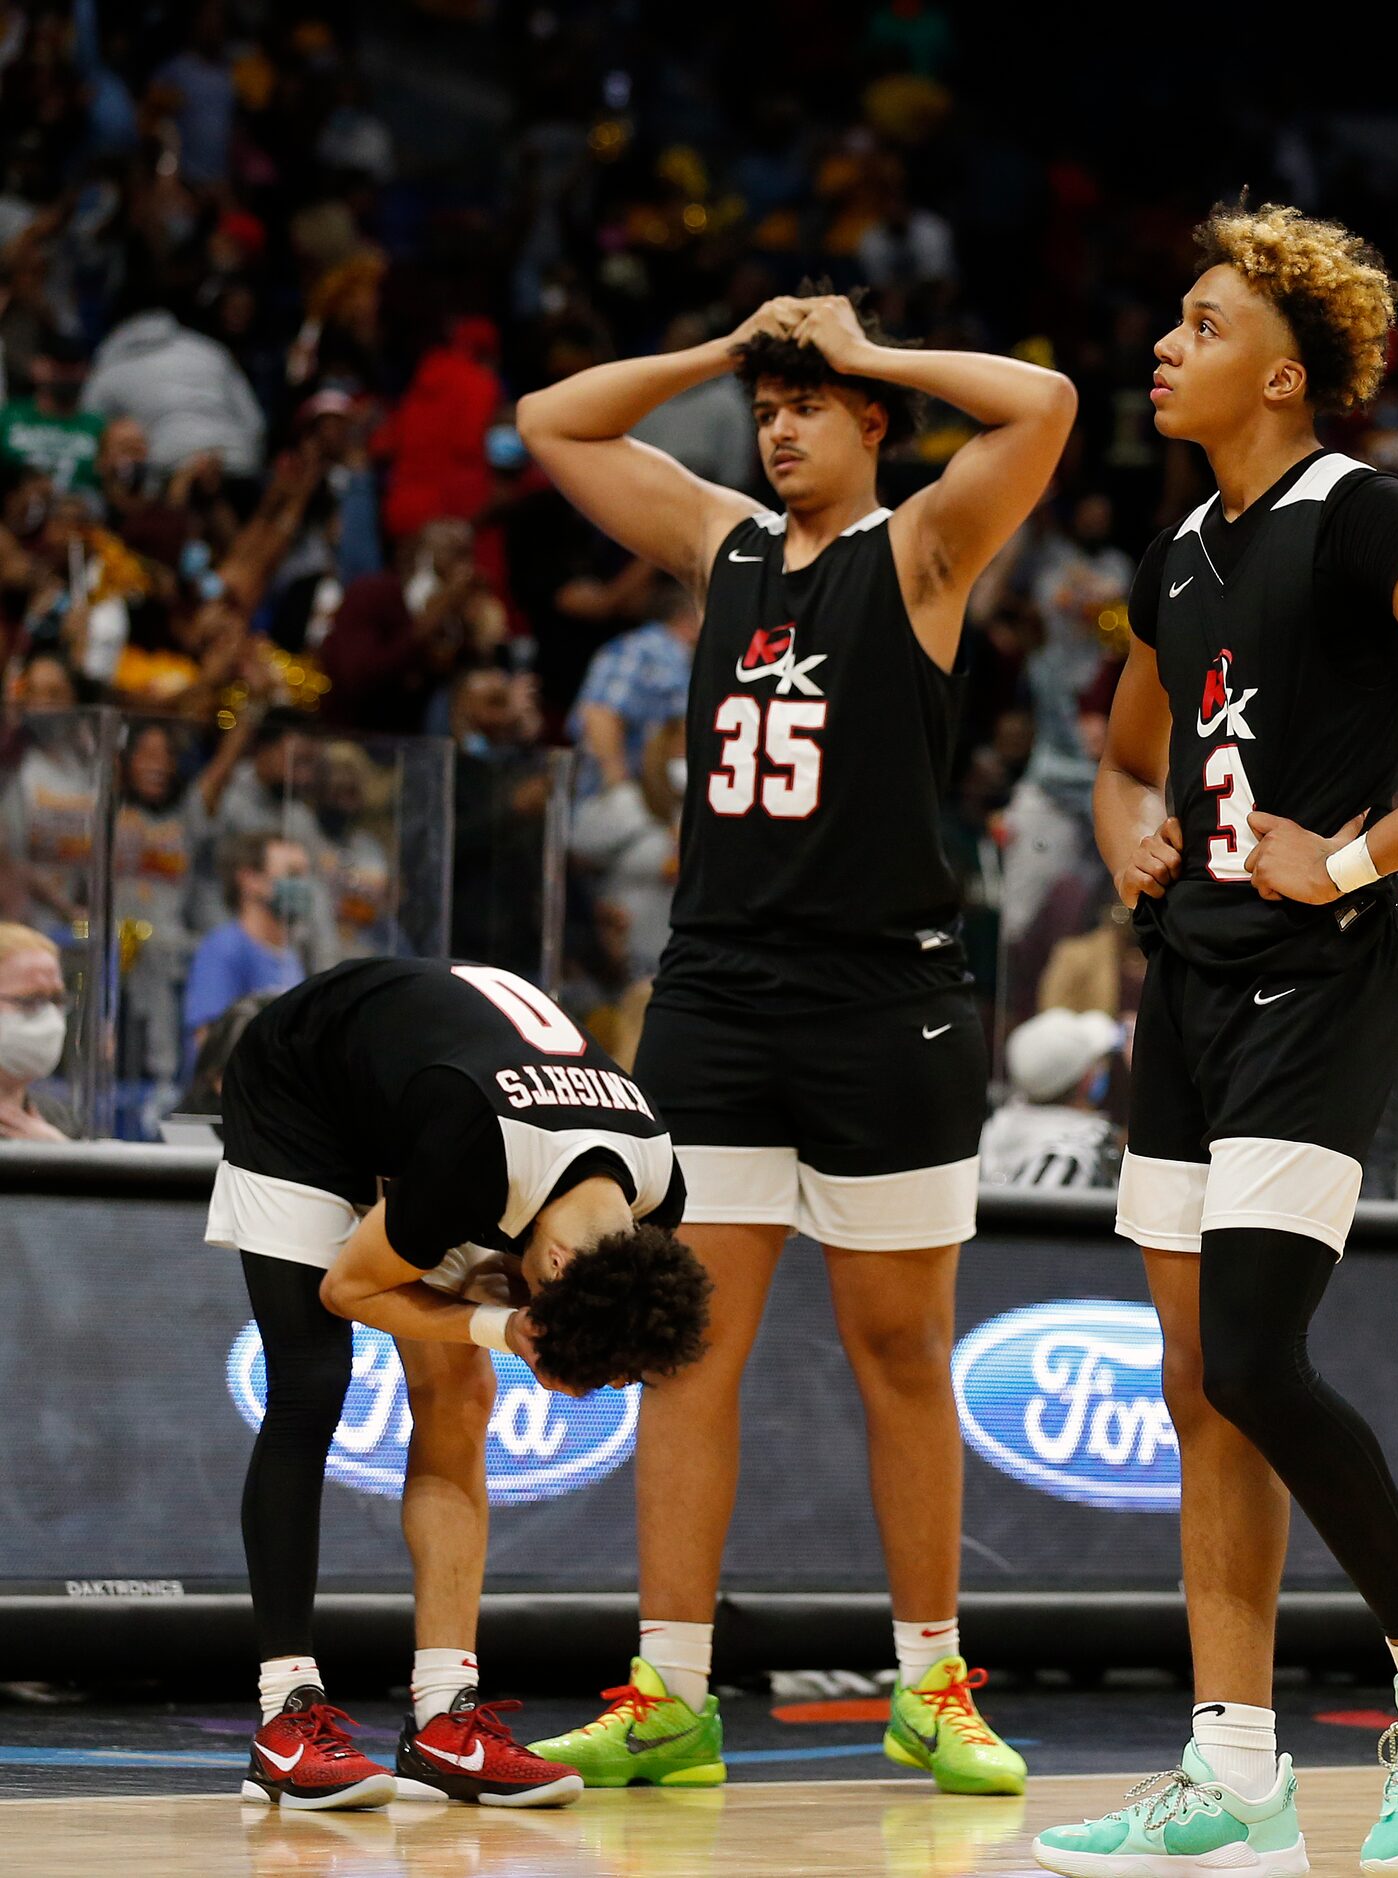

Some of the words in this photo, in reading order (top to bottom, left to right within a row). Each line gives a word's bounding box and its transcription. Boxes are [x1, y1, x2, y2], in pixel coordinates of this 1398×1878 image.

[706, 693, 830, 821] 35
[1202, 742, 1260, 883] 3
[450, 964, 588, 1057] 0
[1024, 1330, 1181, 1466] For
